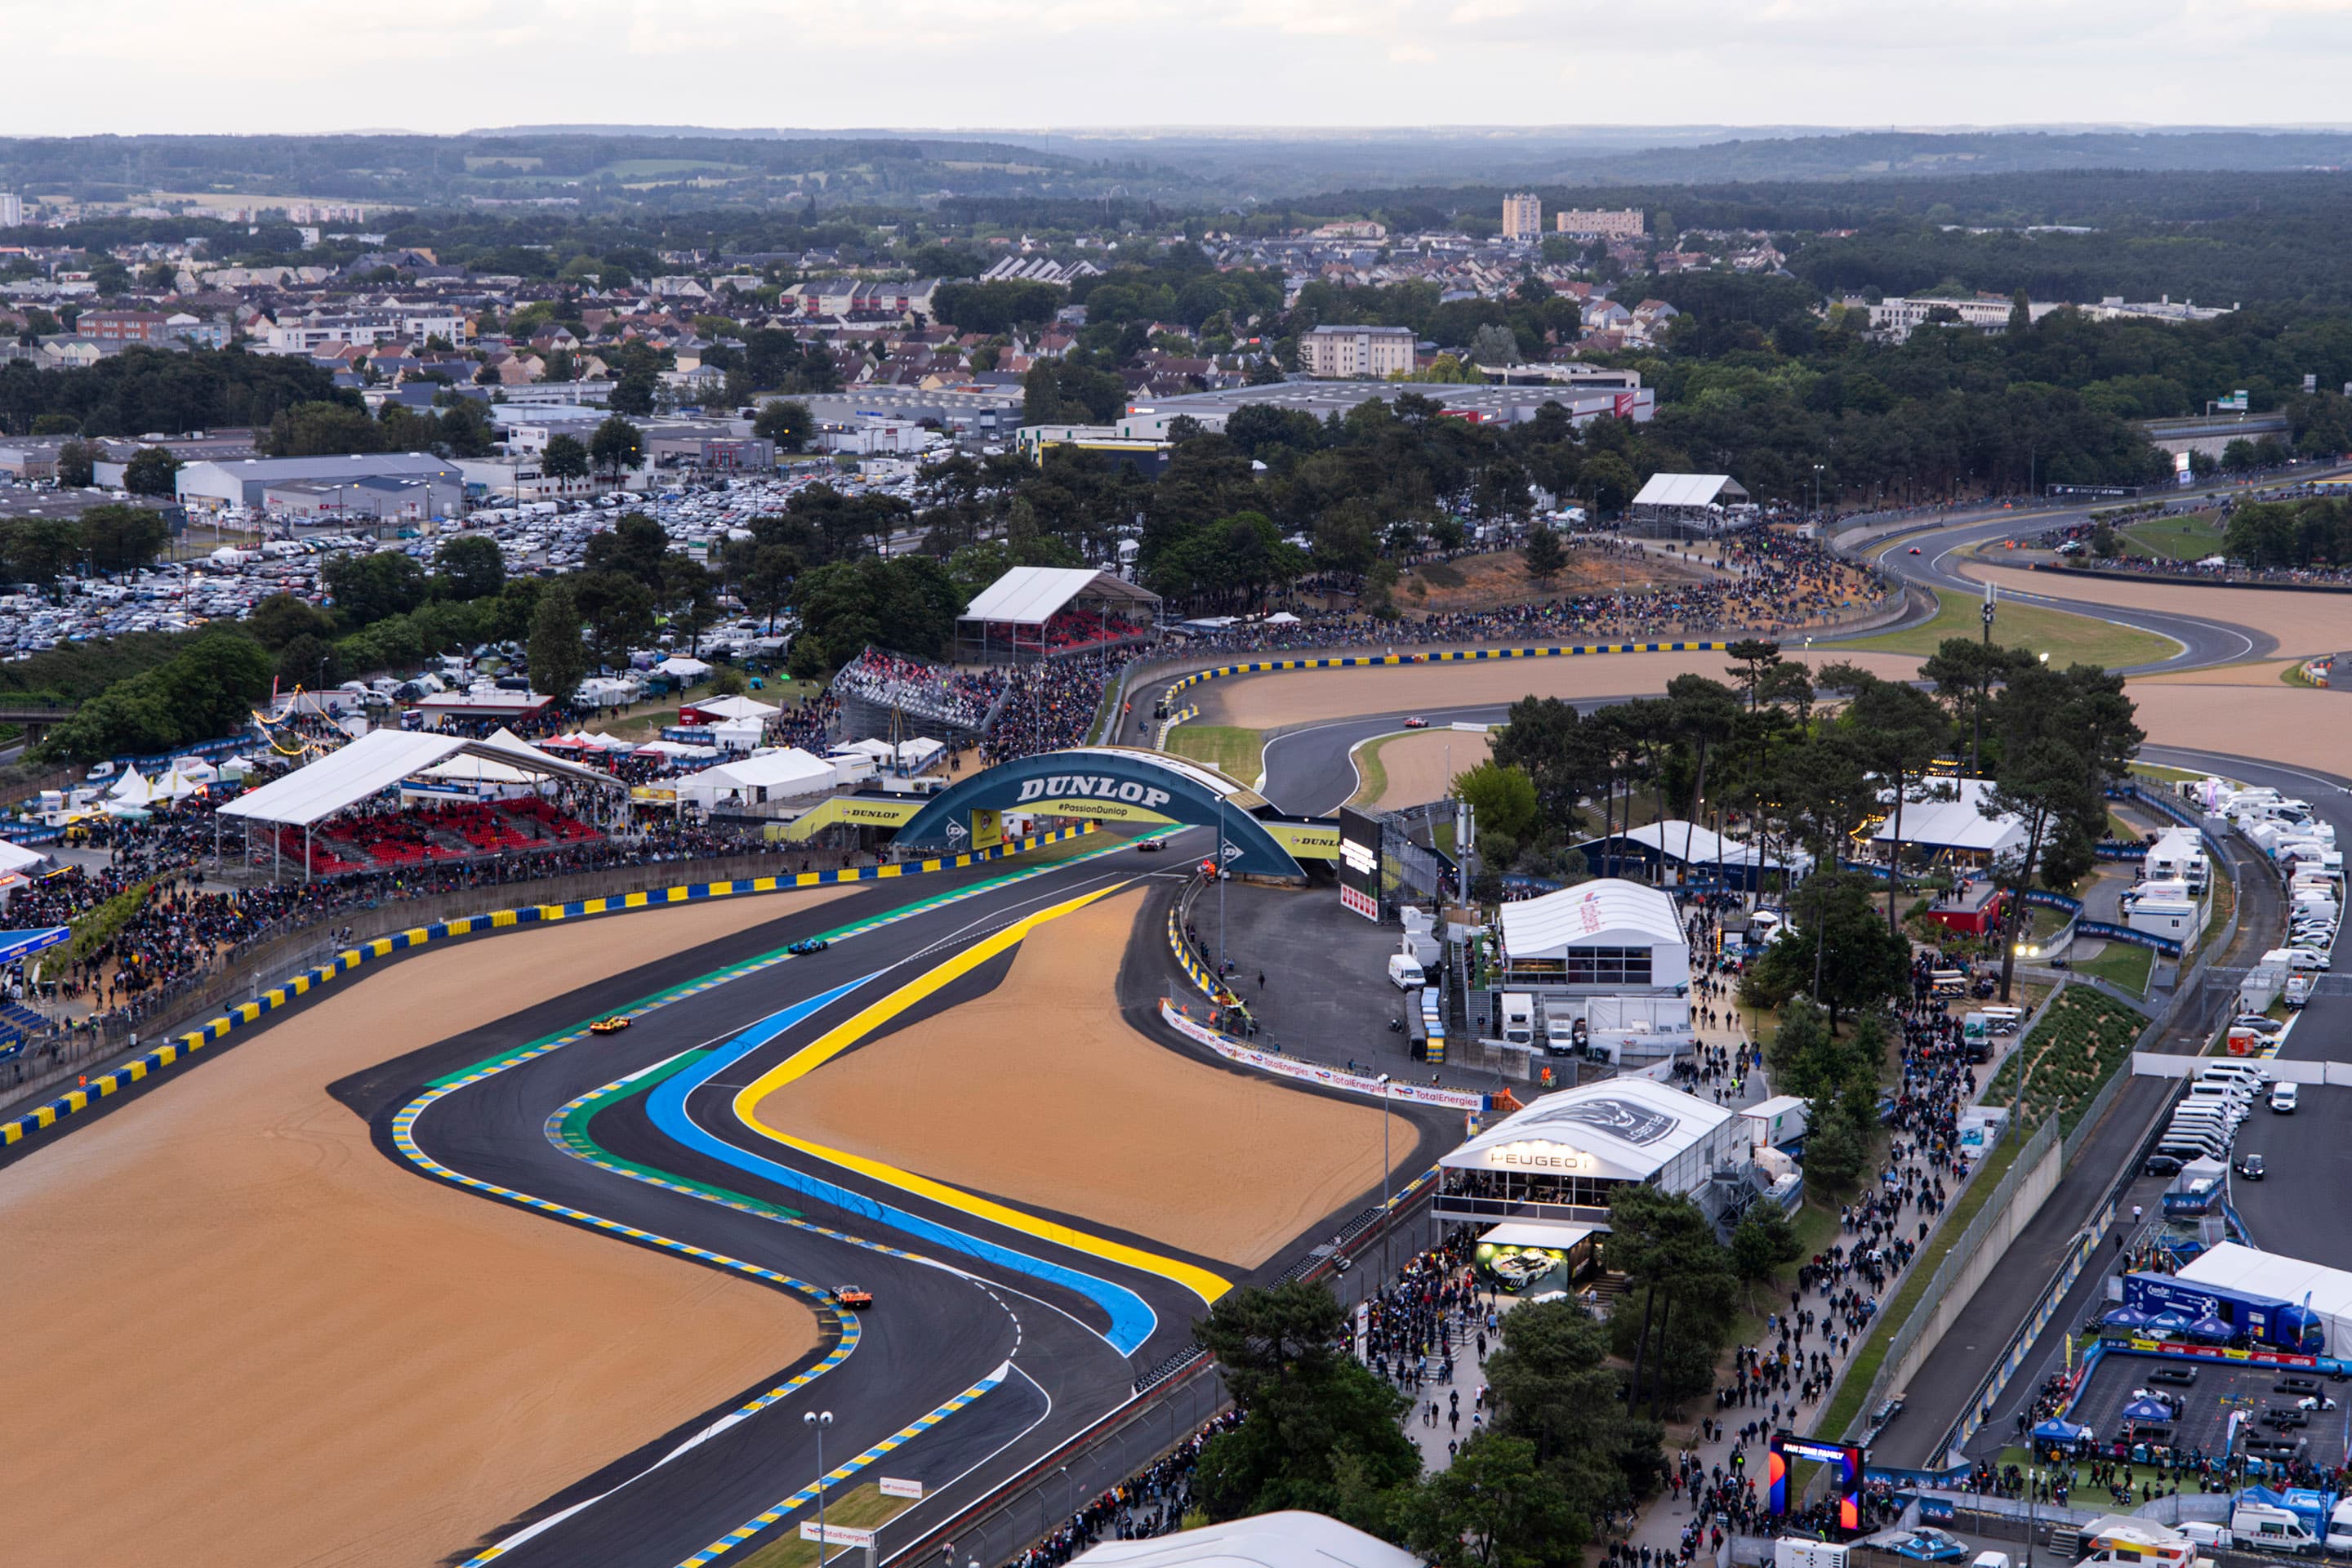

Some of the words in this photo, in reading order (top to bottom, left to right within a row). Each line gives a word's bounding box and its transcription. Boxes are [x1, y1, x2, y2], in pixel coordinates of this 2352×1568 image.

[1017, 775, 1170, 808] DUNLOP
[852, 809, 900, 819] DUNLOP
[1058, 804, 1128, 817] #PassionDunlop
[1264, 1058, 1308, 1076] TotalEnergies
[1332, 1074, 1388, 1093] TotalEnergies
[1416, 1090, 1478, 1107] TotalEnergies
